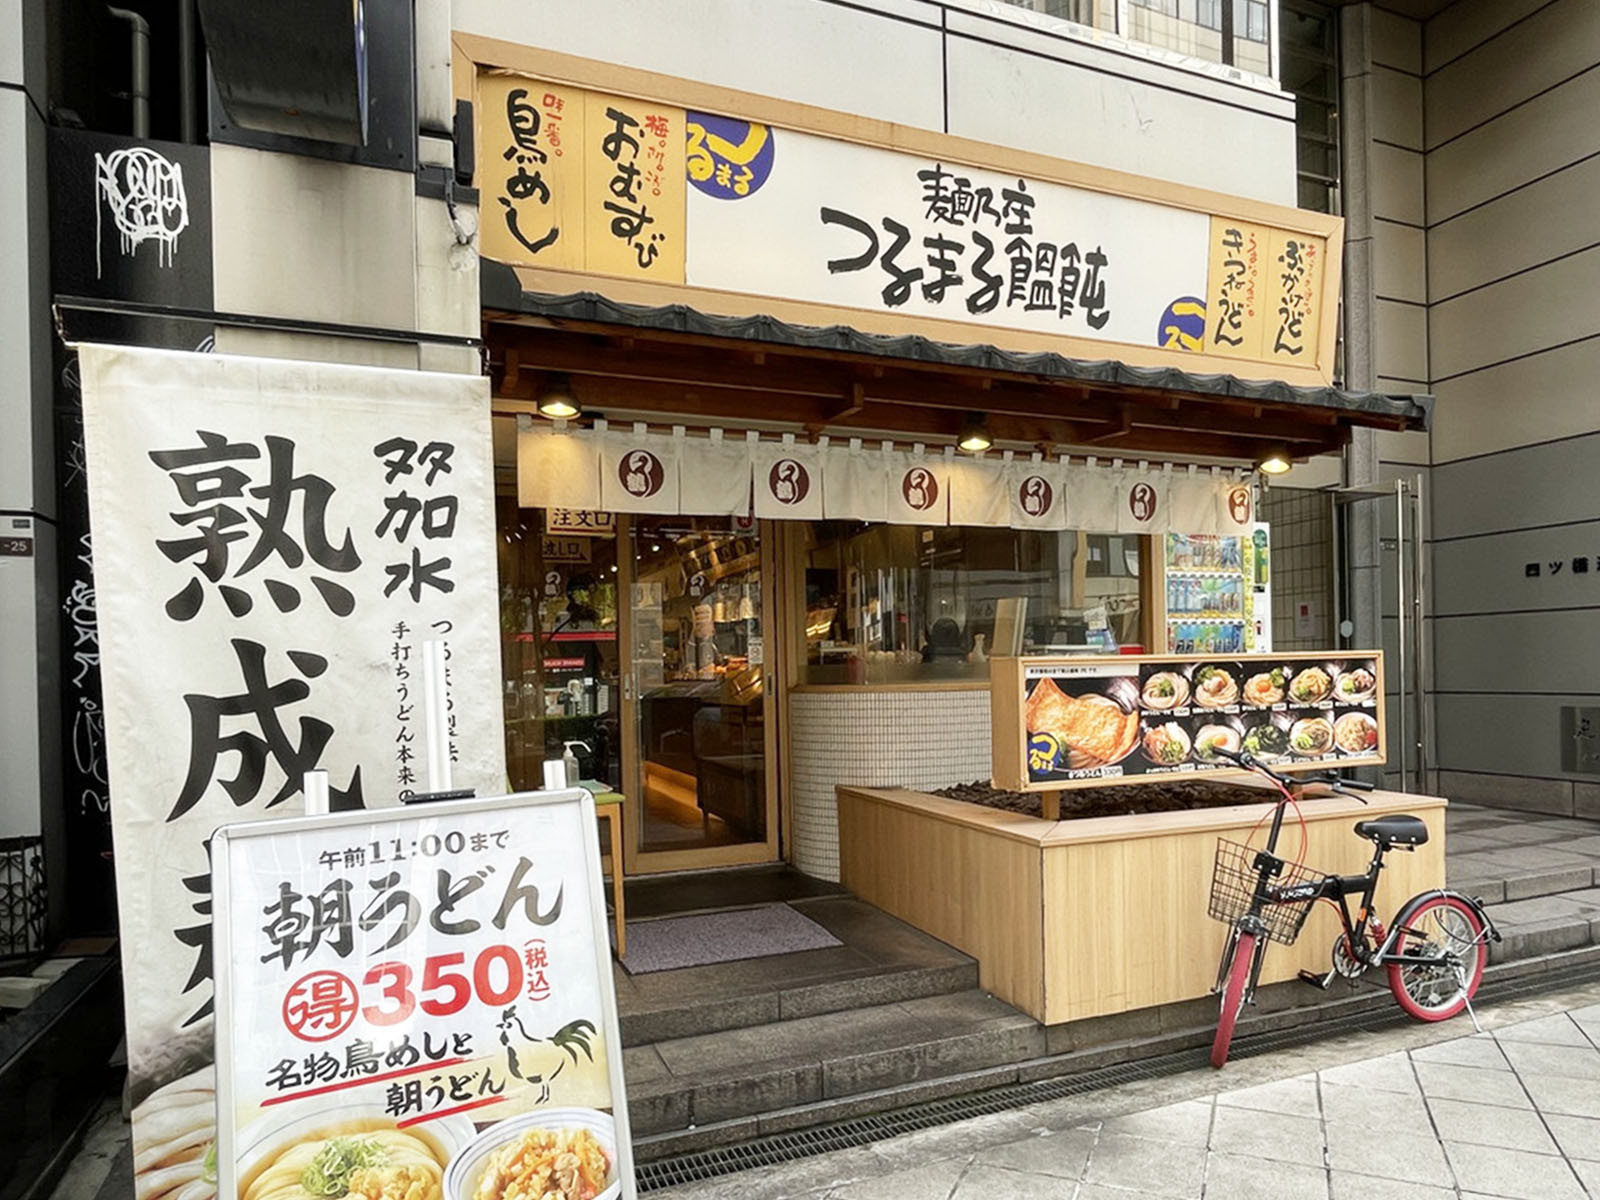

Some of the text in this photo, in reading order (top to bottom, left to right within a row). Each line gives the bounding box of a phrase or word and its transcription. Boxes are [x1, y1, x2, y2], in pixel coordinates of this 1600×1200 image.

[497, 89, 559, 254] 鳥めし
[602, 107, 666, 268] おむすび
[820, 207, 1110, 330] つるまる饂飩
[1214, 228, 1246, 346] きつねうどん
[1274, 240, 1306, 355] ぶっかけうどん
[553, 508, 611, 528] 注文口
[1525, 556, 1600, 578] 四ツ橋
[318, 829, 511, 872] 午前11:00まで
[260, 856, 565, 971] 朝うどん
[284, 971, 357, 1037] 得
[362, 944, 524, 1028] 350
[265, 1031, 474, 1091] 名物鳥めしと
[385, 1069, 505, 1116] 朝うどん
